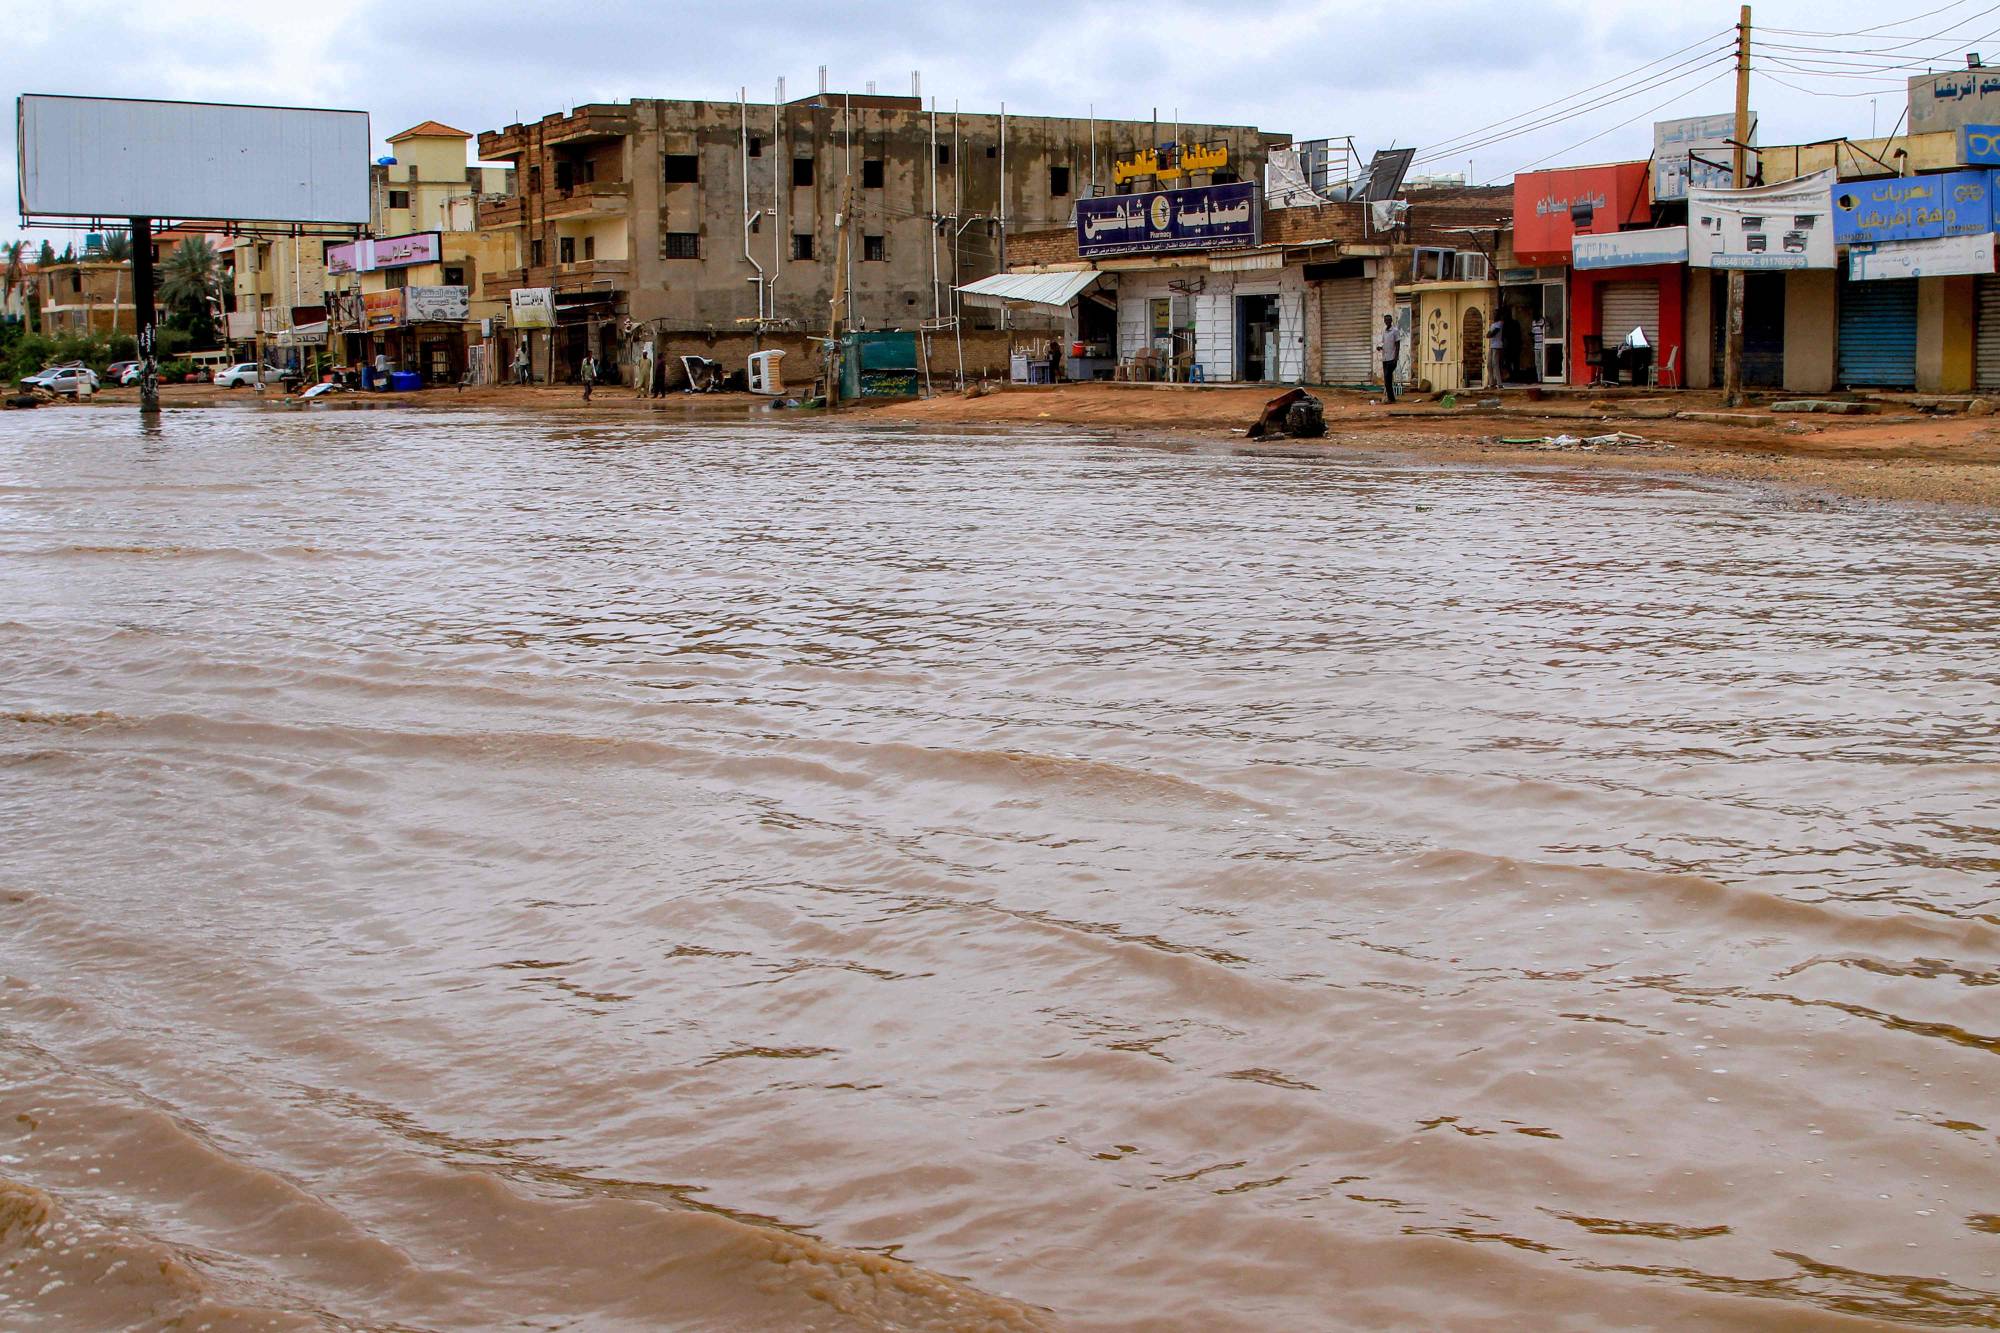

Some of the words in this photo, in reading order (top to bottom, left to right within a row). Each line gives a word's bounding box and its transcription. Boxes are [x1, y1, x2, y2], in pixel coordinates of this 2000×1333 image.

[1114, 147, 1157, 185] شاهين
[1181, 143, 1228, 177] صيدلية
[1871, 184, 1933, 205] بصريات
[1084, 199, 1145, 240] شاهين
[1177, 196, 1250, 233] صيدلية
[1917, 206, 1956, 227] وهج
[1150, 231, 1172, 239] Pharmacy
